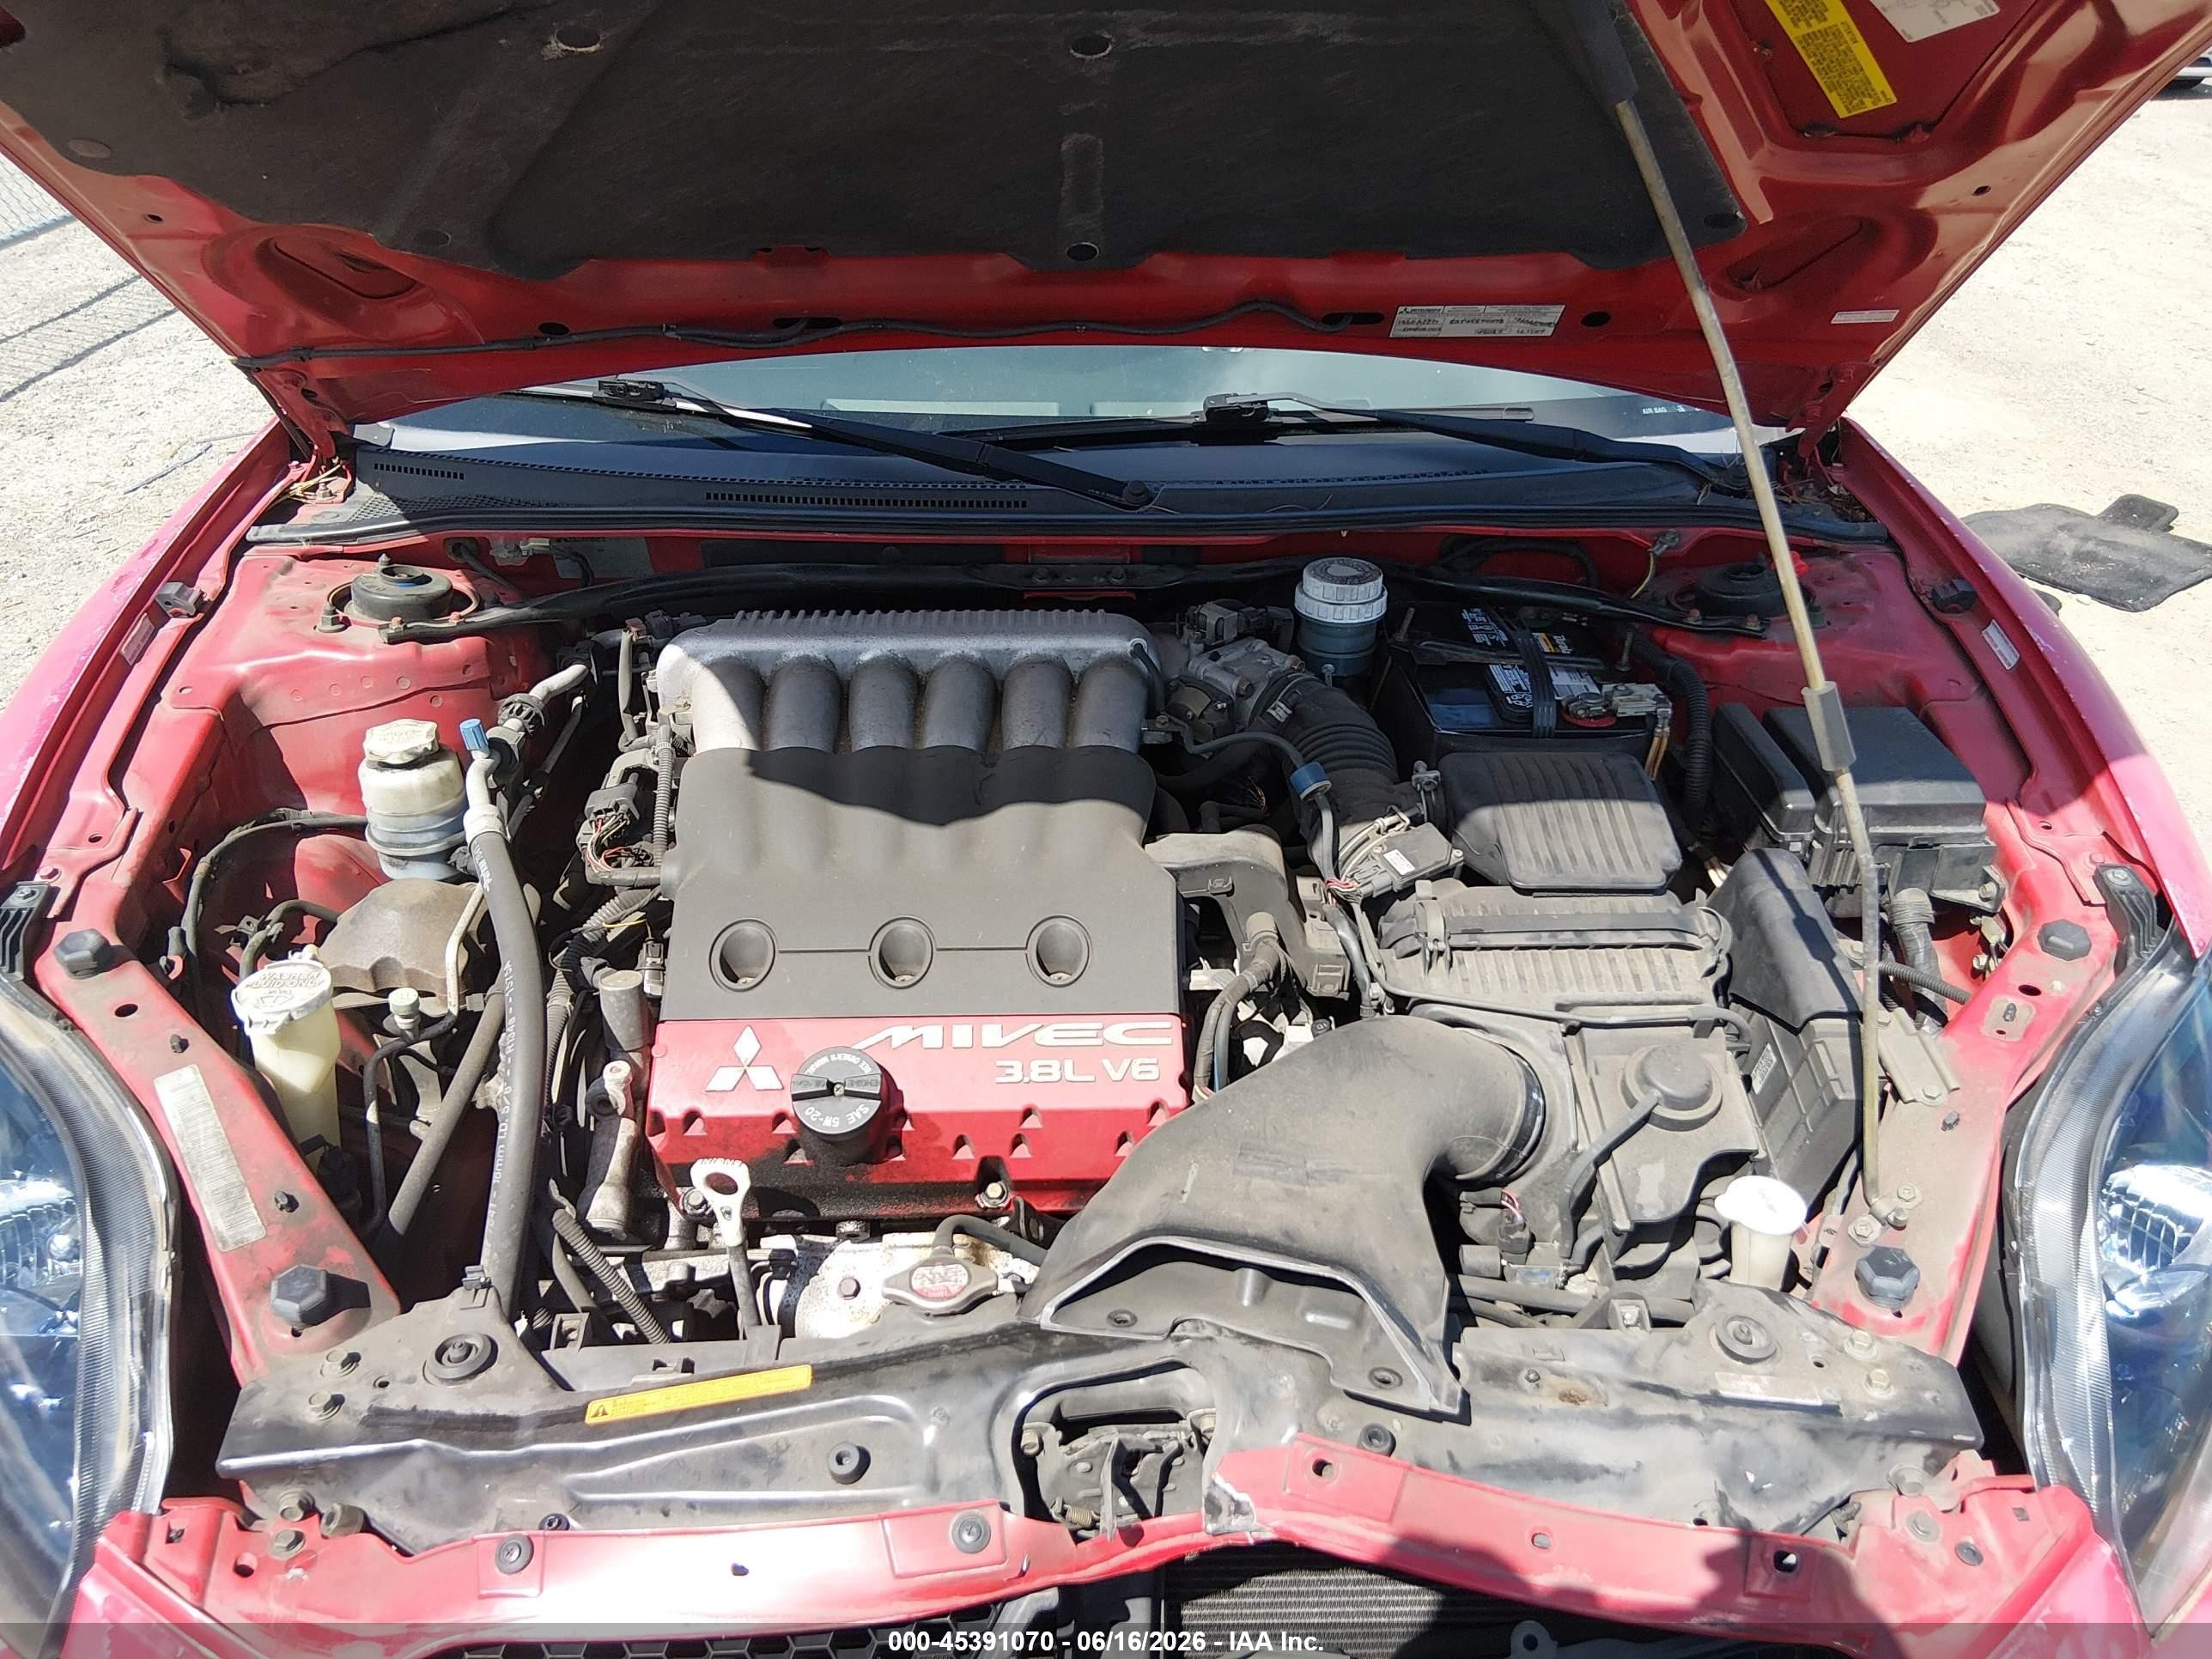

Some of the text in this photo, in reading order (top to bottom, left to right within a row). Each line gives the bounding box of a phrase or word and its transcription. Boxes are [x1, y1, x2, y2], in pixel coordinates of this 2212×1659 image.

[850, 1021, 1174, 1049] MIVEC
[994, 1058, 1161, 1084] 3.8L V6
[805, 1103, 870, 1127] SAE 5W-20
